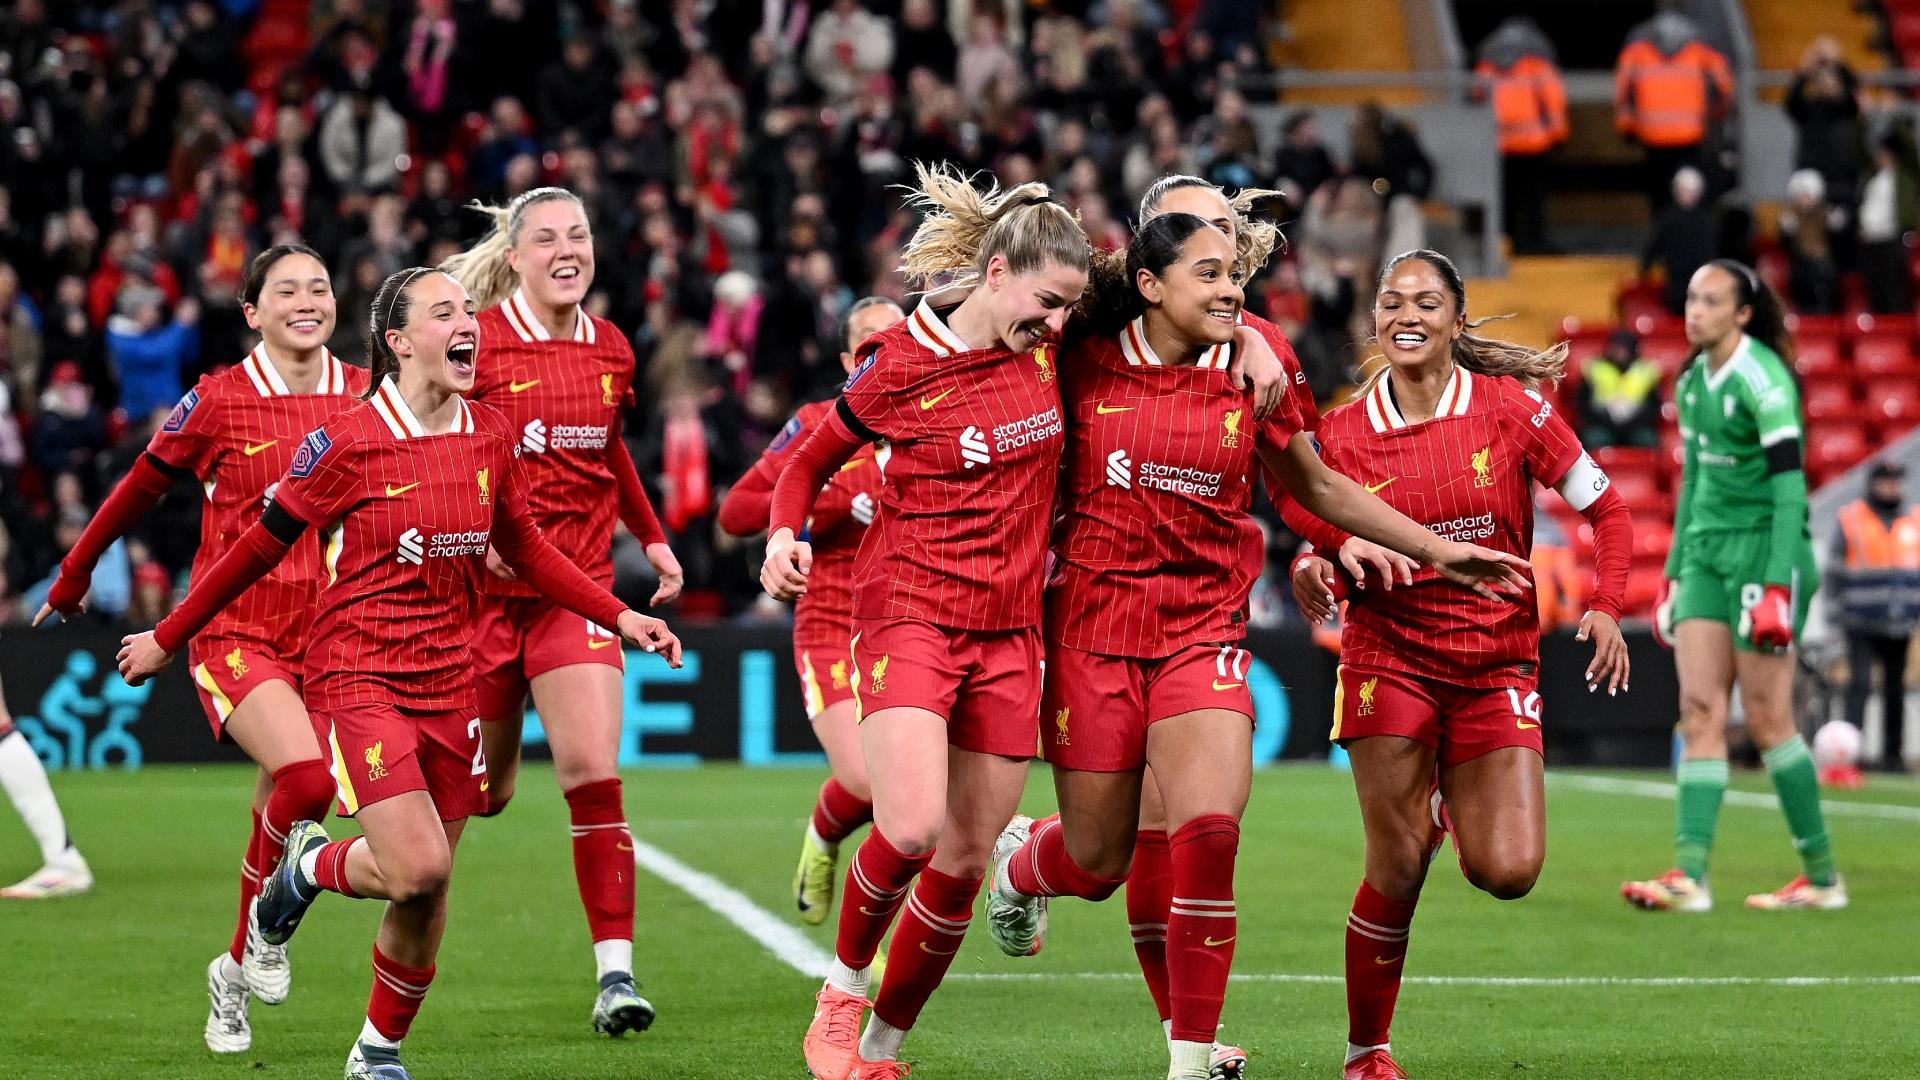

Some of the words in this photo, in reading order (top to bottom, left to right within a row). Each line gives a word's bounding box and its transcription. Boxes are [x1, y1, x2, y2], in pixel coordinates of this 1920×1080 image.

[551, 424, 608, 437] standard
[993, 405, 1058, 440] standard
[551, 437, 607, 449] chartered
[997, 418, 1063, 453] chartered
[1139, 461, 1222, 485] standard
[1138, 474, 1220, 497] chartered
[1423, 511, 1492, 533] andard
[430, 529, 490, 545] standard
